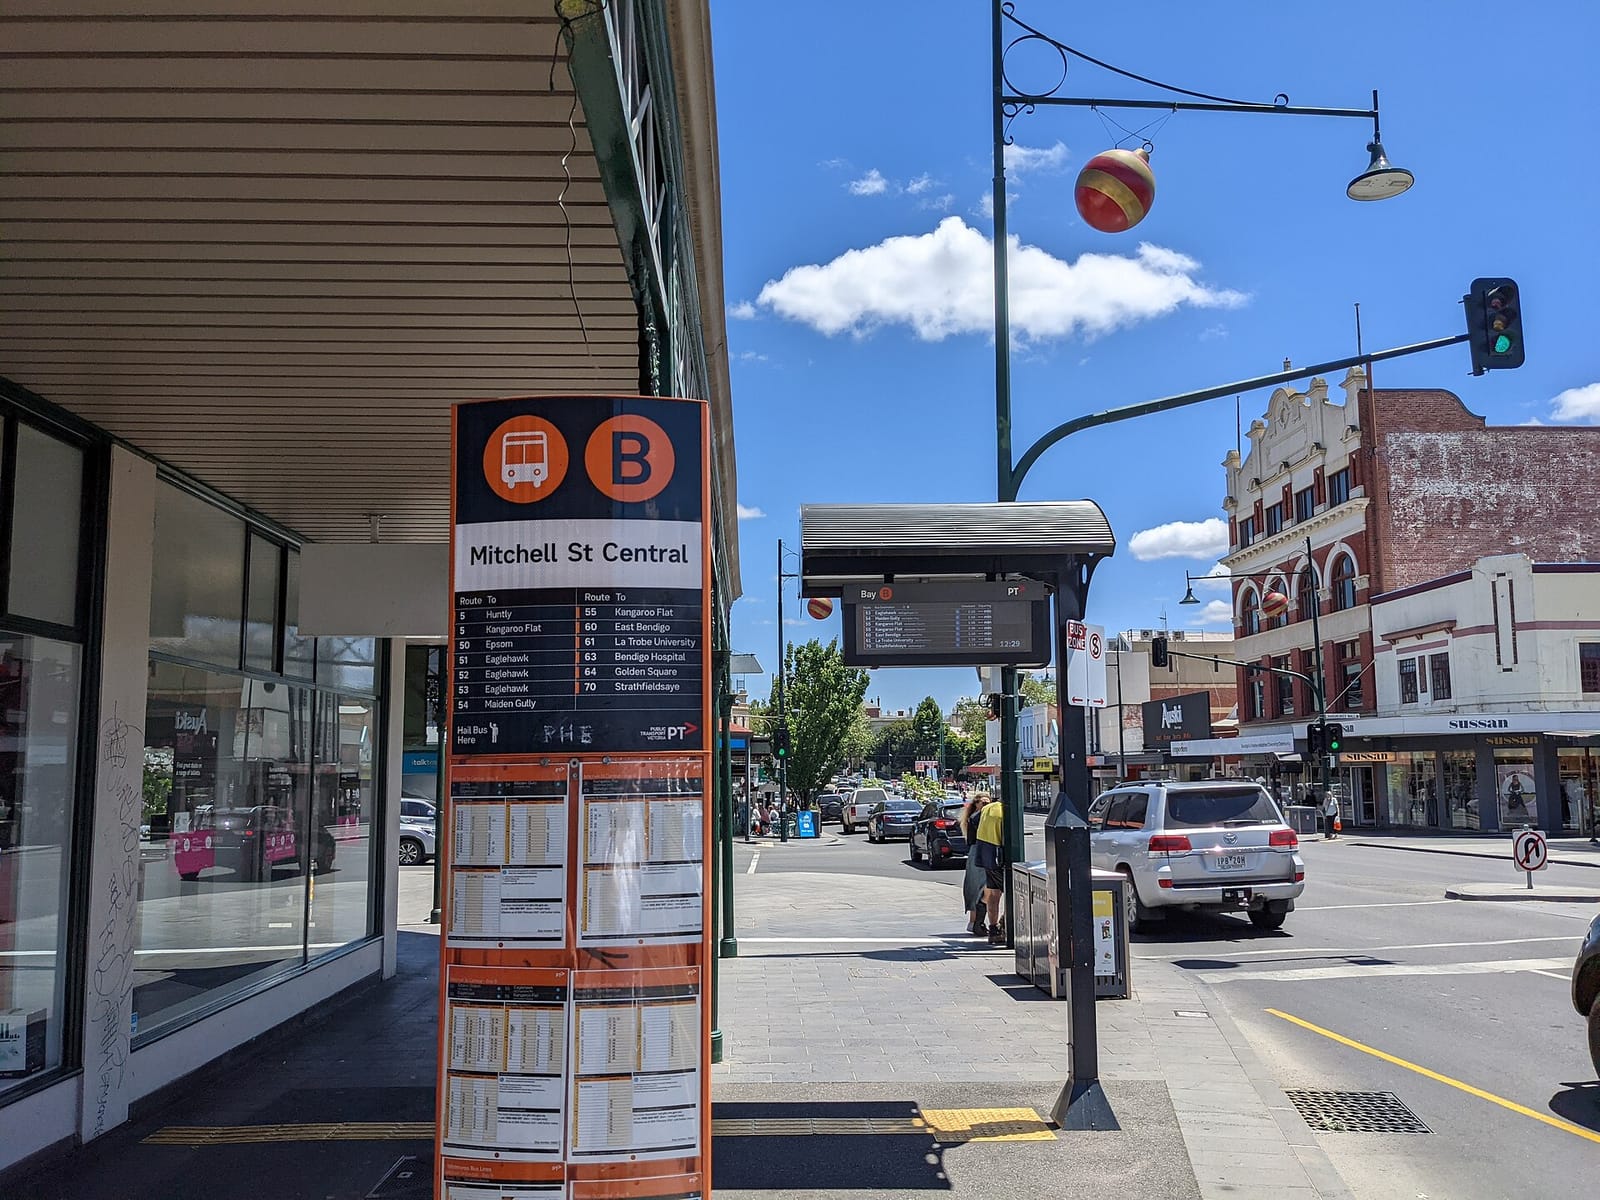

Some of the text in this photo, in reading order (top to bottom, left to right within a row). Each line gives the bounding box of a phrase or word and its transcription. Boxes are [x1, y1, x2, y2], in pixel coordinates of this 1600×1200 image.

[613, 432, 652, 485] B
[470, 542, 688, 566] Mitchell St Central
[861, 590, 876, 600] Bay
[1008, 587, 1019, 596] PT
[460, 596, 496, 605] Route To
[585, 593, 626, 601] Route To
[460, 612, 465, 620] 5
[486, 610, 512, 620] Huntly
[585, 608, 597, 616] 55
[615, 608, 673, 618] Kangaroo Flat
[460, 626, 465, 634] 5
[486, 624, 541, 635] Kangaroo Flat
[585, 623, 597, 631] 60
[615, 622, 670, 633] East Bendigo
[1070, 623, 1083, 636] BUS
[460, 641, 470, 649] 50
[486, 640, 513, 650] Epsom
[585, 638, 595, 646] 61
[615, 637, 696, 648] La Trobe University
[1068, 636, 1085, 650] ZONE
[459, 656, 468, 664] 51
[486, 654, 528, 665] Eaglehawk
[585, 653, 597, 661] 63
[615, 652, 685, 662] Bendigo Hospital
[459, 671, 469, 679] 52
[485, 669, 528, 680] Eaglehawk
[584, 667, 597, 676] 64
[615, 667, 677, 677] Golden Square
[458, 686, 469, 694] 53
[485, 684, 528, 695] Eaglehawk
[584, 682, 596, 691] 70
[615, 682, 680, 692] Strathfieldsaye
[458, 701, 468, 709] 54
[485, 699, 536, 709] Maiden Gully
[1161, 703, 1183, 729] Auski
[1449, 718, 1509, 730] sussan
[457, 726, 488, 734] Hail Bus
[668, 727, 686, 740] PT
[457, 736, 476, 744] Here
[1485, 736, 1538, 745] sussan
[1346, 752, 1388, 762] sussan
